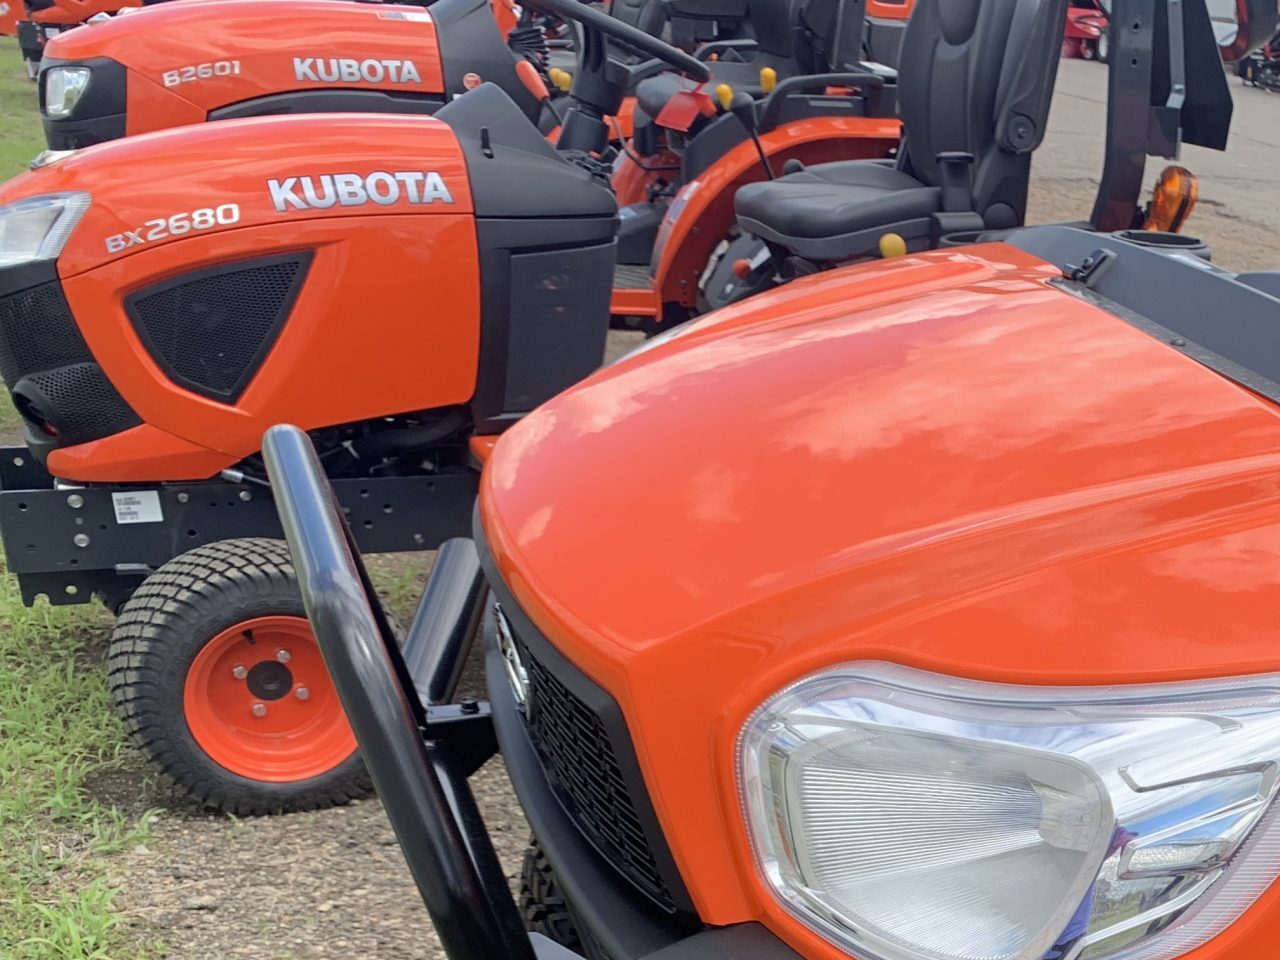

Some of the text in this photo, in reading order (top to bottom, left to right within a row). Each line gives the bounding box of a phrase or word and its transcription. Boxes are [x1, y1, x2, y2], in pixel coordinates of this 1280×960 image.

[163, 57, 422, 87] B2601 KUBOTA
[105, 171, 454, 254] BX2680 KUBOTA
